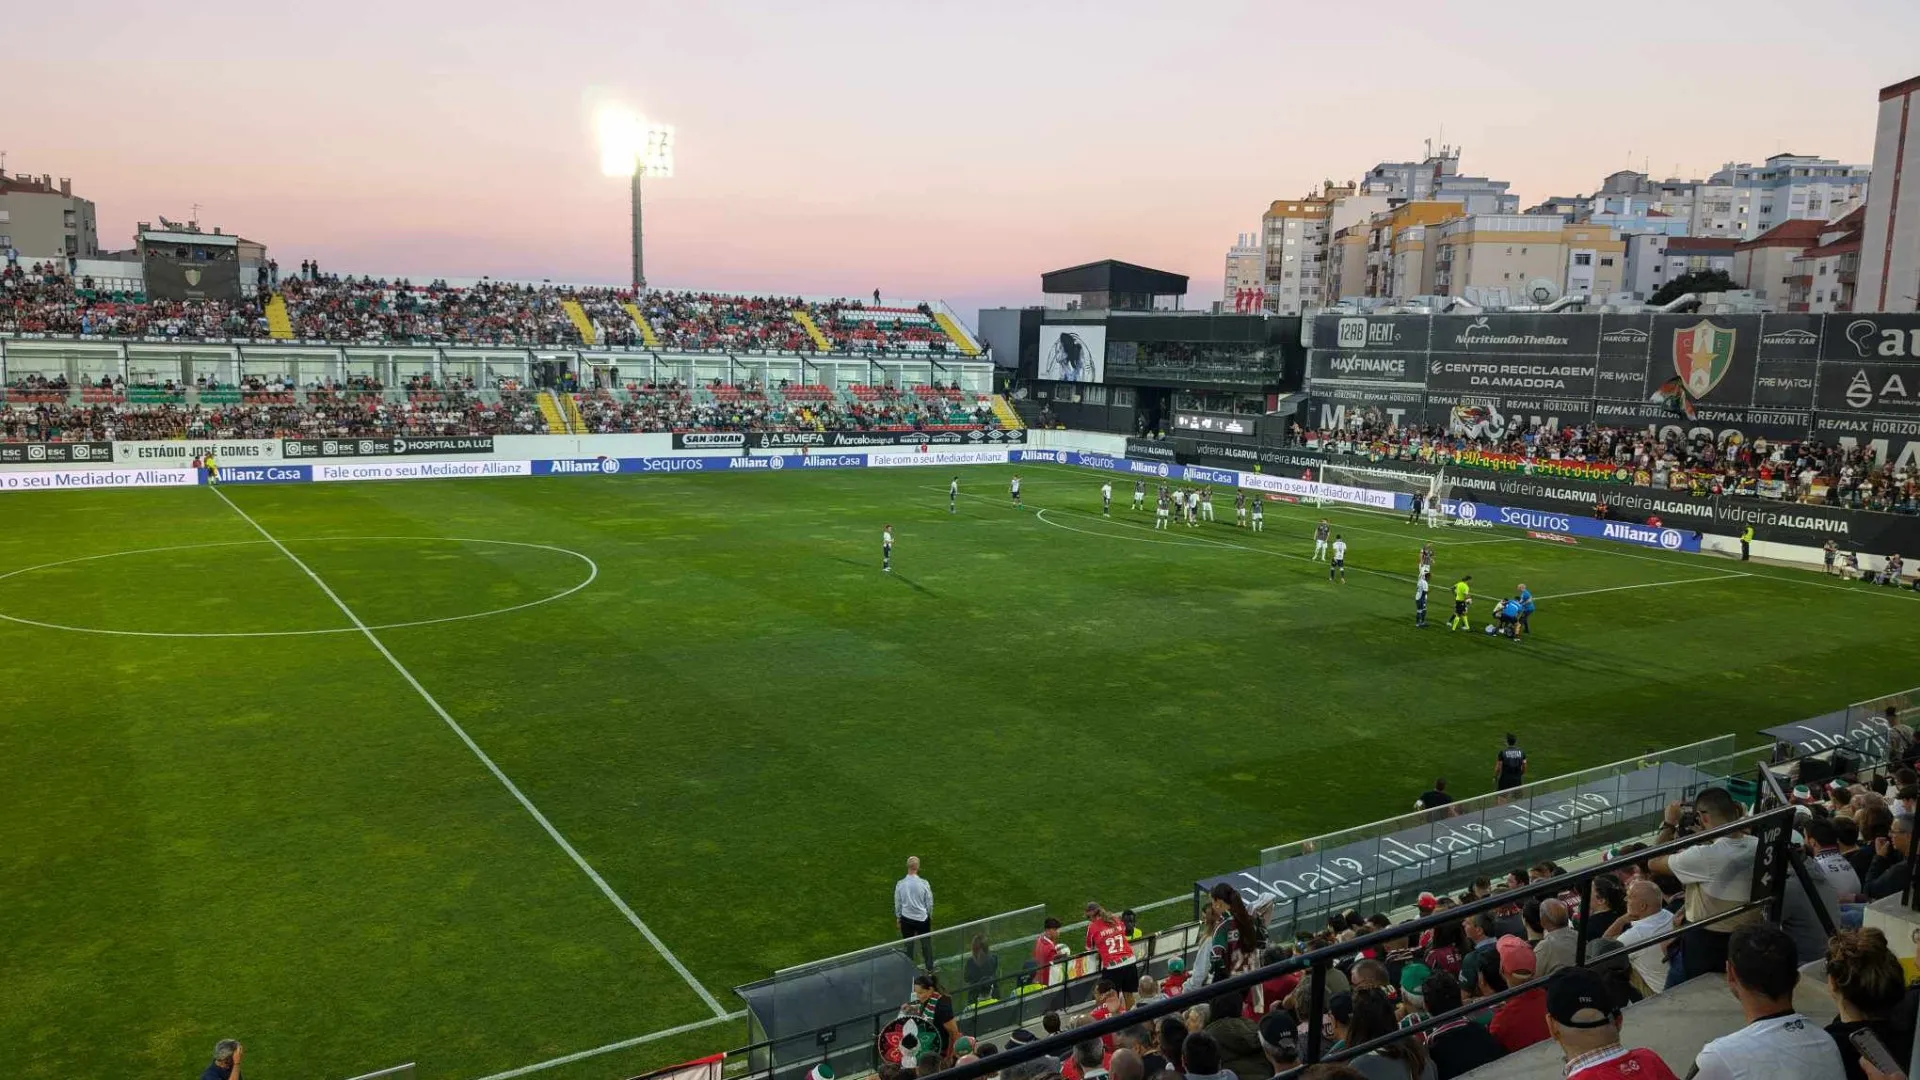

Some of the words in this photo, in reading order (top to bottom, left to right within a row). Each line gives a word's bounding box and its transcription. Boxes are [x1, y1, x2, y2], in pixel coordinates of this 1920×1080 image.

[1368, 323, 1395, 341] RENT
[1455, 334, 1568, 346] NutritionOnTheBox
[1330, 357, 1405, 373] MAXFINANCE
[1445, 363, 1497, 374] CENTRO
[1500, 365, 1594, 376] RECICLAGEM
[1471, 377, 1489, 386] DA
[1491, 378, 1565, 388] AMADORA
[1879, 374, 1907, 397] A
[1429, 396, 1458, 405] RE/MAX
[1507, 401, 1541, 409] RE/MAX
[1543, 400, 1590, 412] HORIZONTE
[1596, 405, 1636, 416] RE/MAX
[1697, 411, 1743, 422] RE/MAX
[1747, 411, 1808, 426] HORIZONTE
[1818, 419, 1868, 431] RE/MAX
[408, 441, 455, 450] HOSPITAL
[457, 440, 471, 449] DA
[474, 438, 492, 448] LUZ
[783, 434, 825, 442] SMEFA
[139, 444, 185, 458] ESTÁDIO
[189, 444, 218, 457] JOSÉ
[222, 445, 259, 457] GOMES
[874, 455, 892, 465] Fale
[894, 456, 912, 464] com
[921, 456, 934, 464] seu
[936, 453, 975, 463] Mediador
[977, 452, 1002, 462] Allianz
[1021, 451, 1054, 461] Allianz
[1148, 448, 1173, 456] ALGARVIA
[1196, 446, 1223, 456] vidreira
[1225, 449, 1257, 460] ALGARVIA
[551, 461, 599, 472] Allianz
[643, 458, 703, 472] Seguros
[730, 457, 768, 468] Allianz
[804, 455, 836, 466] Allianz
[838, 455, 861, 466] Casa
[1079, 453, 1114, 468] Seguros
[1131, 461, 1157, 474] Allianz
[1260, 452, 1290, 464] vidreira
[1291, 456, 1327, 468] ALGARVIA
[214, 467, 264, 482] Allianz
[268, 468, 300, 480] Casa
[324, 467, 349, 478] Fale
[353, 470, 381, 478] com
[385, 469, 393, 477] o
[396, 468, 417, 477] seu
[421, 463, 478, 475] Mediador
[482, 461, 522, 473] Allianz
[1183, 467, 1211, 480] Allianz
[1212, 472, 1231, 484] Casa
[9, 478, 17, 487] o
[24, 477, 51, 487] seu
[55, 472, 130, 486] Mediador
[136, 471, 186, 484] Allianz
[1450, 476, 1496, 491] ALGARVIA
[1245, 473, 1261, 486] Fale
[1263, 479, 1282, 489] com
[1284, 483, 1290, 491] o
[1292, 485, 1307, 494] seu
[1356, 491, 1386, 505] Allianz
[1500, 479, 1543, 497] vidreira
[1544, 488, 1597, 503] ALGARVIA
[1602, 493, 1652, 510] vidreira
[1653, 501, 1713, 518] ALGARVIA
[1500, 506, 1570, 532] Seguros
[1718, 505, 1777, 525] vidreira
[1778, 515, 1848, 534] ALGARVIA
[1604, 523, 1658, 543] Allianz
[1764, 827, 1781, 843] VIP
[1763, 845, 1773, 866] 3
[1105, 934, 1124, 955] 27
